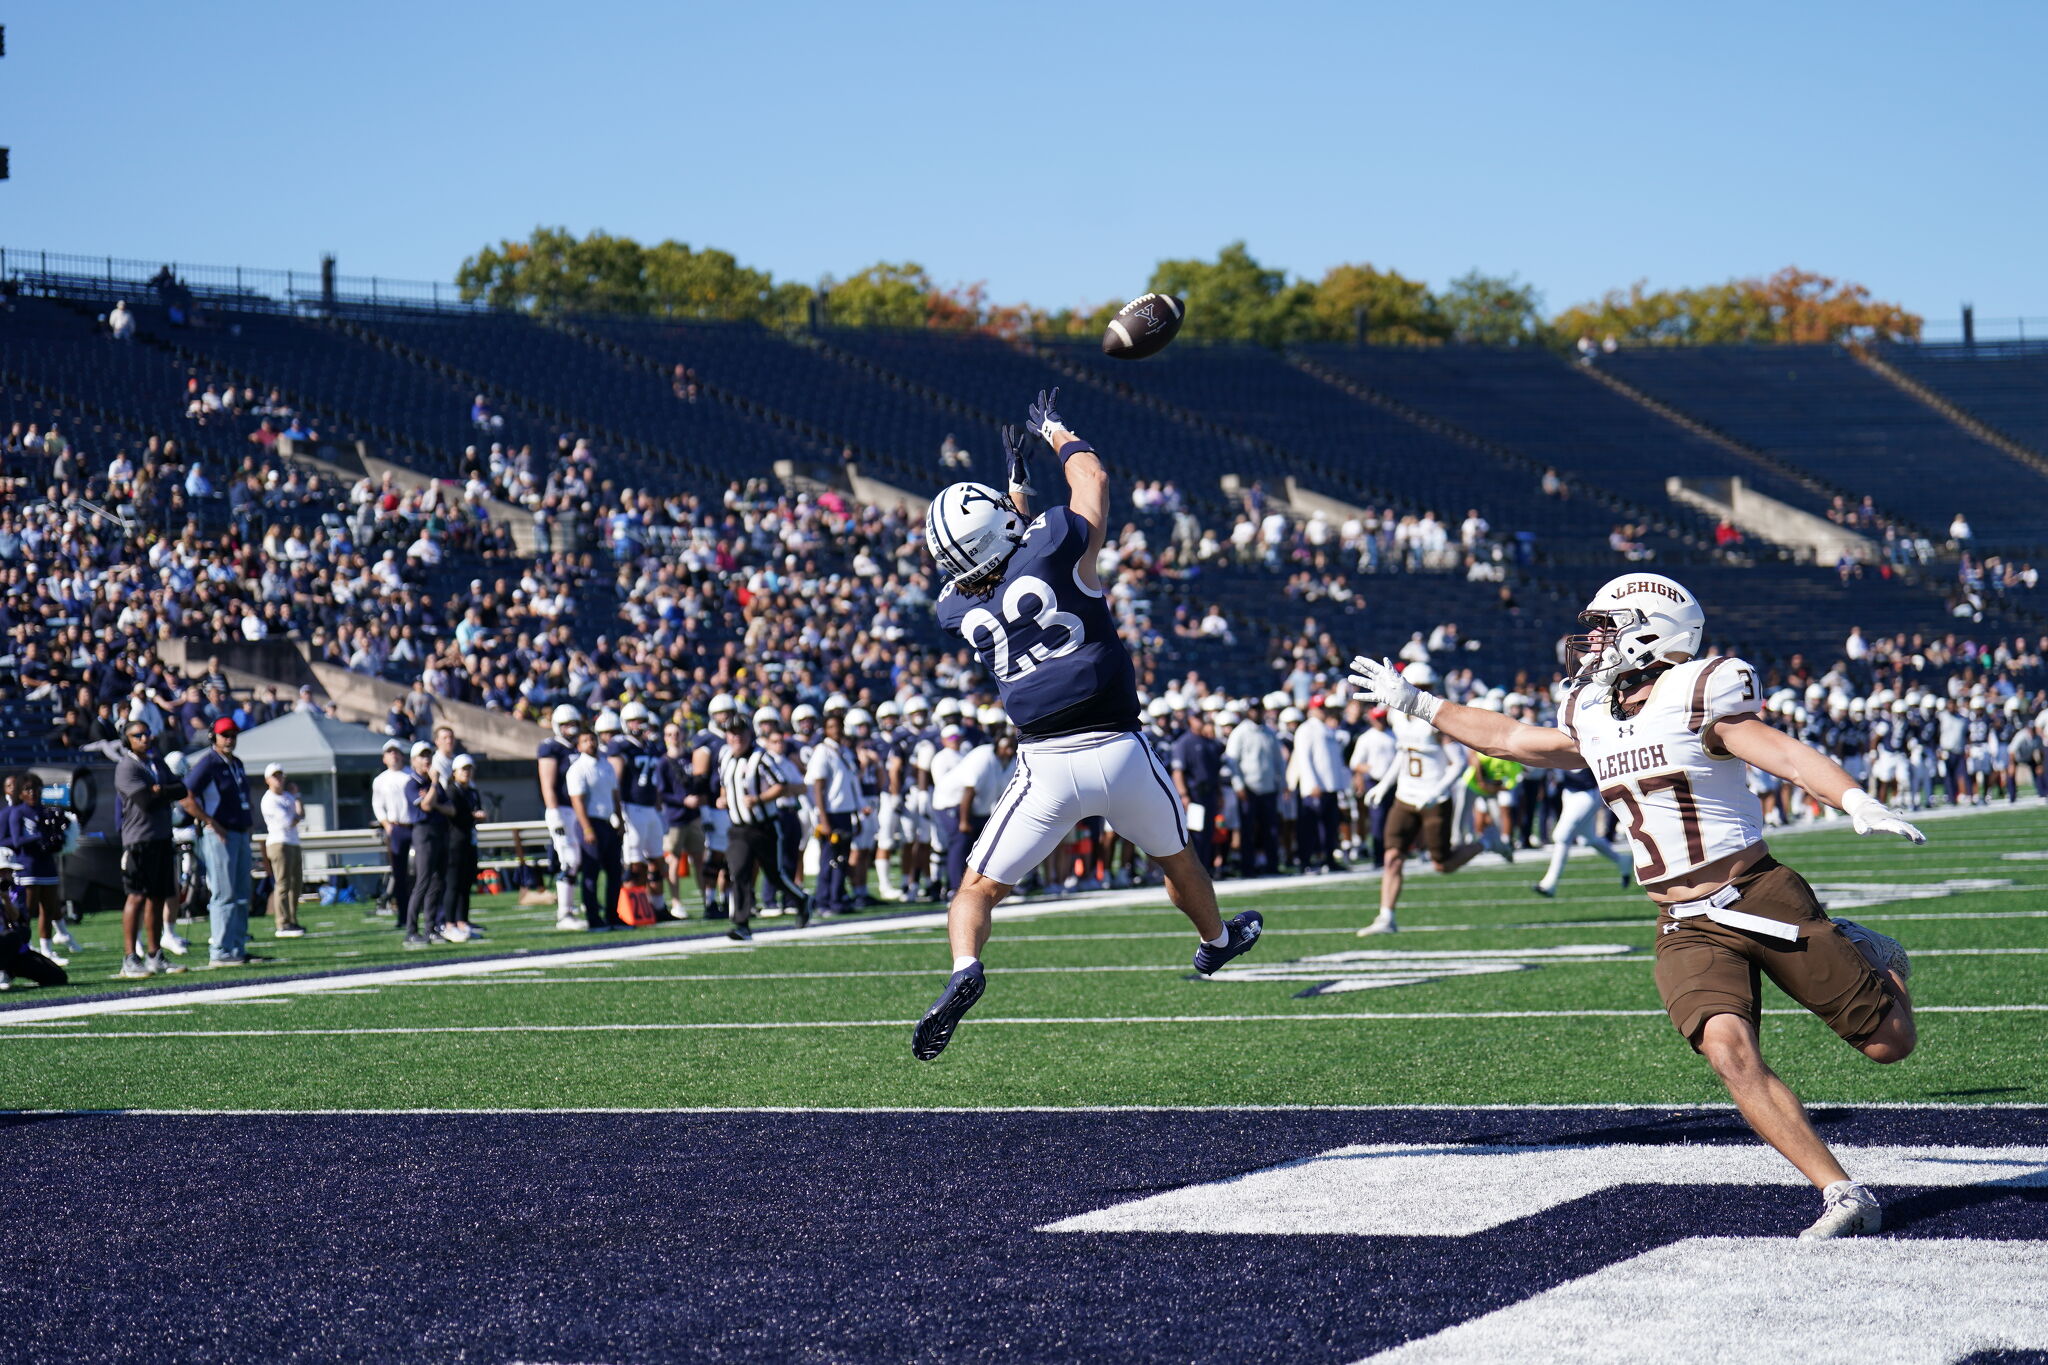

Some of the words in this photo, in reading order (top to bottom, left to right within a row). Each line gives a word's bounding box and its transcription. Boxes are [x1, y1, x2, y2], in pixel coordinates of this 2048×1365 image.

[1134, 303, 1160, 328] Y
[962, 484, 999, 511] Y
[968, 547, 979, 557] 23
[983, 557, 1002, 573] 151
[1616, 581, 1680, 603] LEHIGH
[960, 575, 1086, 683] 23
[1736, 668, 1764, 702] 3
[1597, 743, 1669, 781] LEHIGH
[1599, 768, 1708, 885] 37
[629, 892, 654, 920] 20
